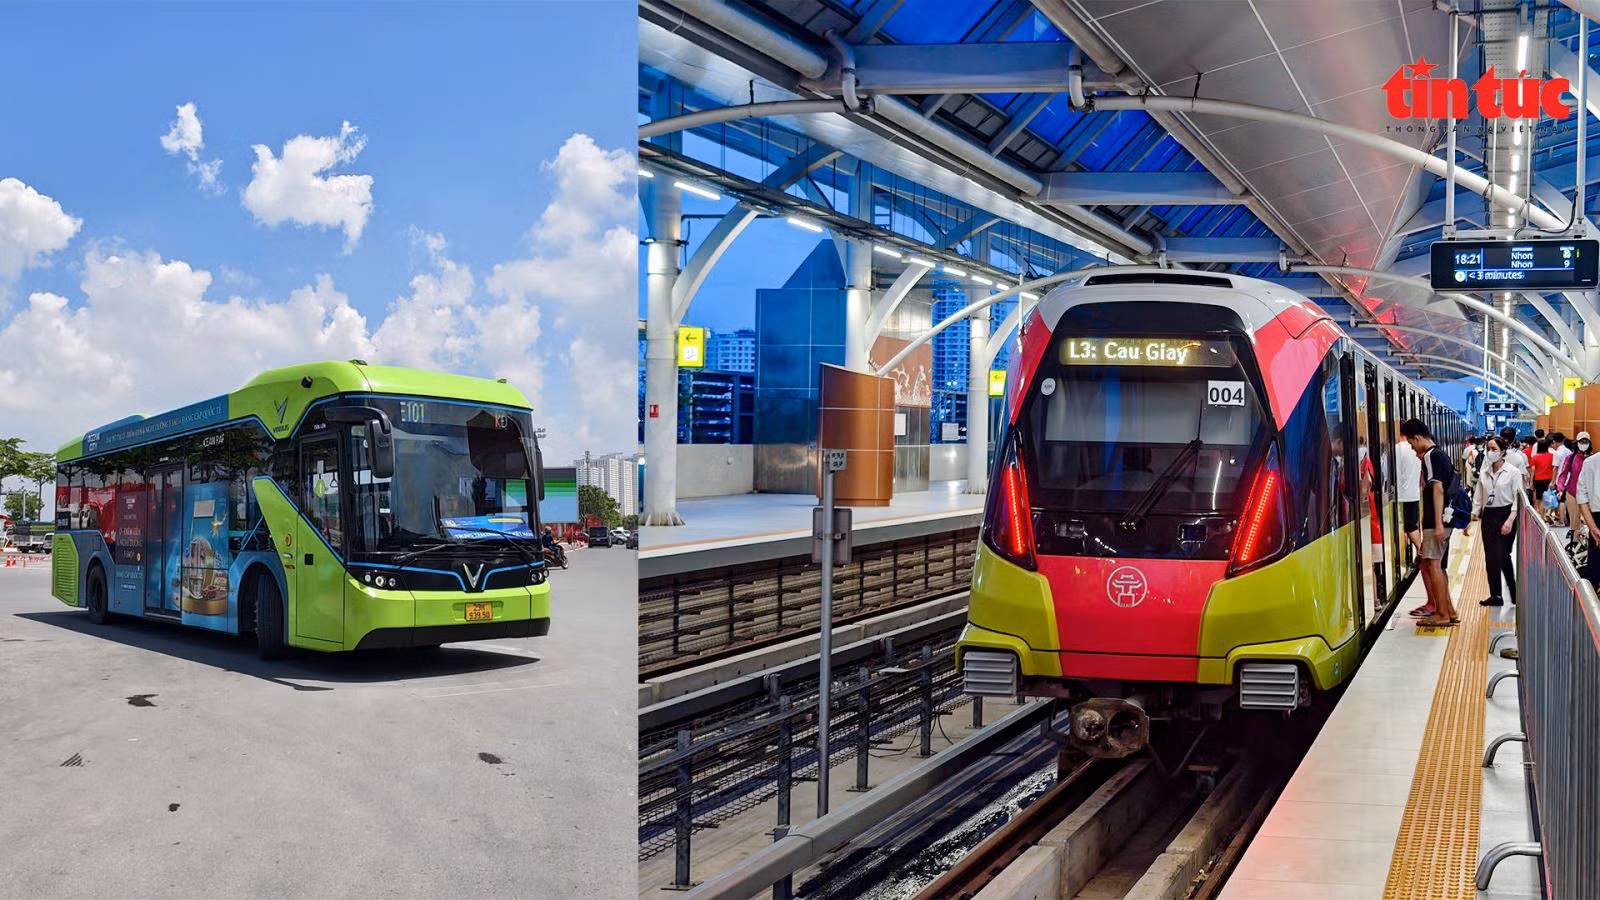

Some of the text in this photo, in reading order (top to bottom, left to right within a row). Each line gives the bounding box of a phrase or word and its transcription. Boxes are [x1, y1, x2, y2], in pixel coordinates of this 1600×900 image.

[1455, 254, 1481, 265] 18:21
[1511, 252, 1533, 260] Nhon
[1511, 260, 1570, 268] Nhon 9
[1485, 271, 1525, 280] minutes
[1069, 341, 1188, 365] L3: Cau Giay
[1209, 387, 1244, 404] 004
[400, 401, 425, 423] E101
